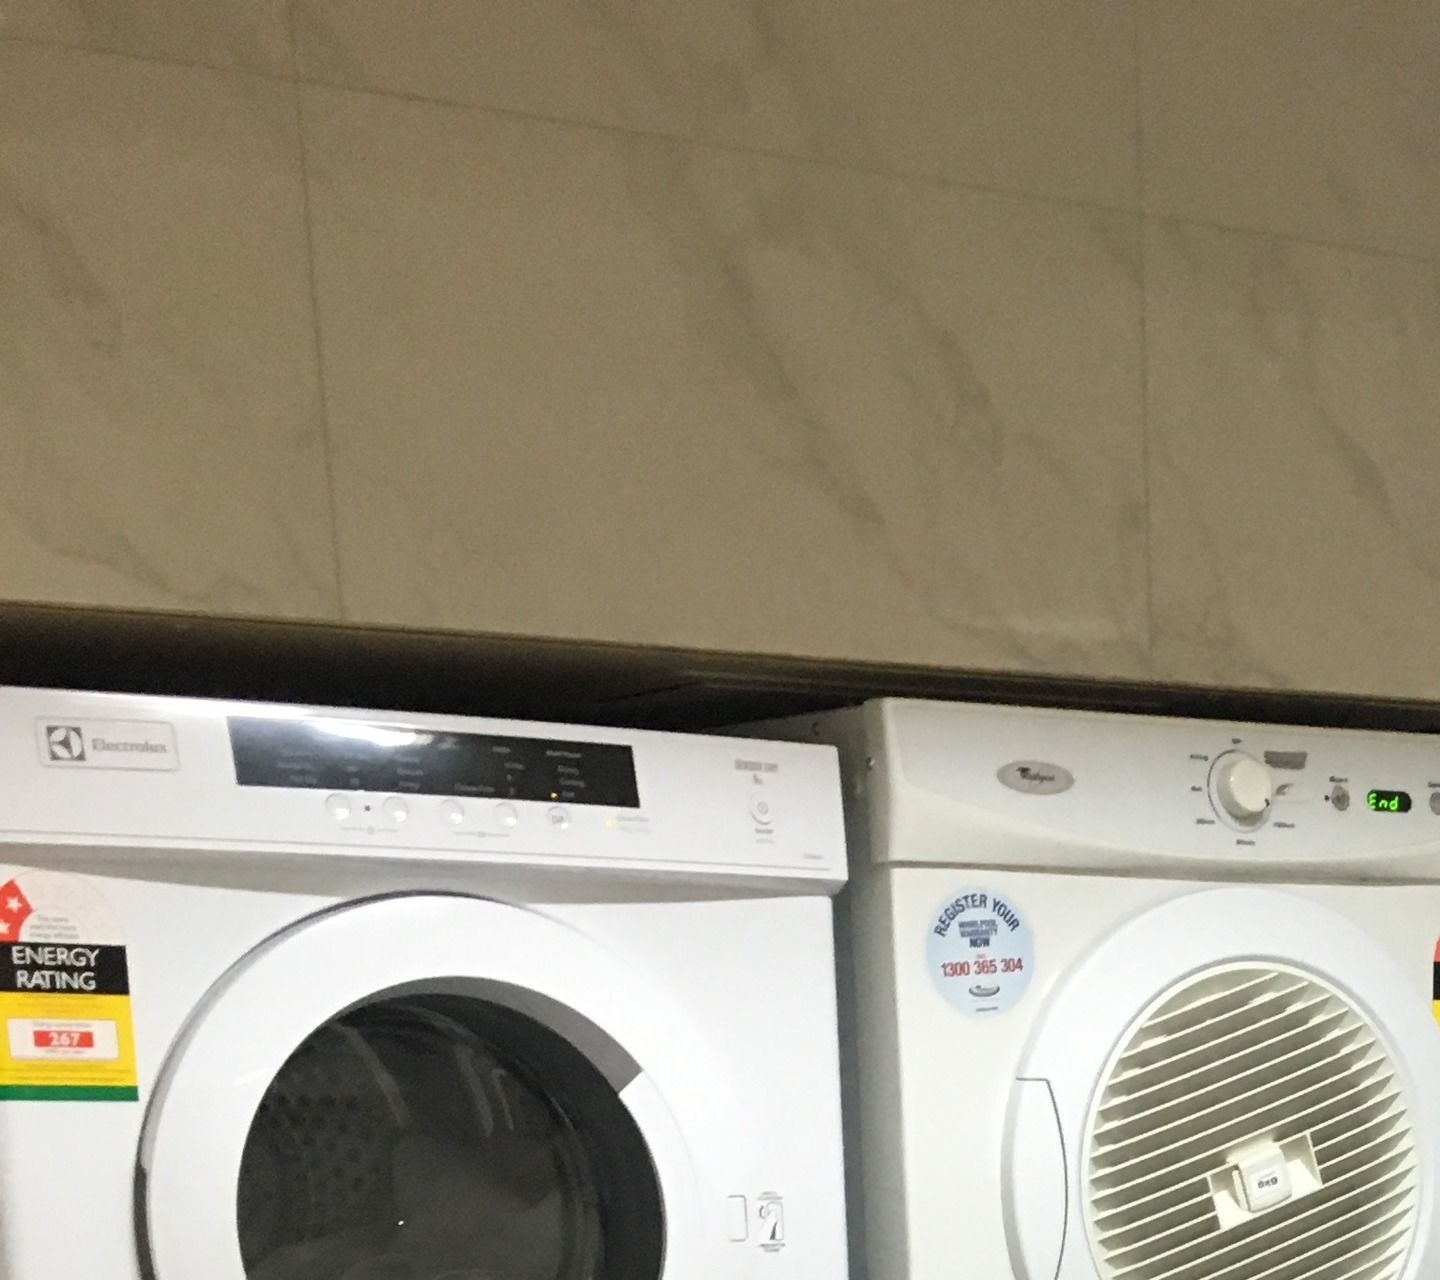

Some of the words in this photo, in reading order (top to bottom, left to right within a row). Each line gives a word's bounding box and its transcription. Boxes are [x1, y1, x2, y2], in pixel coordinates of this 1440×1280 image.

[92, 738, 167, 753] Electrolux
[1367, 793, 1399, 811] End
[934, 893, 988, 938] REGISTER
[991, 898, 1020, 932] YOUR
[11, 945, 100, 967] ENERGY
[941, 961, 970, 977] 1300
[974, 959, 998, 974] 365
[1001, 958, 1023, 973] 304
[16, 970, 97, 991] RATING
[49, 1031, 81, 1047] 267
